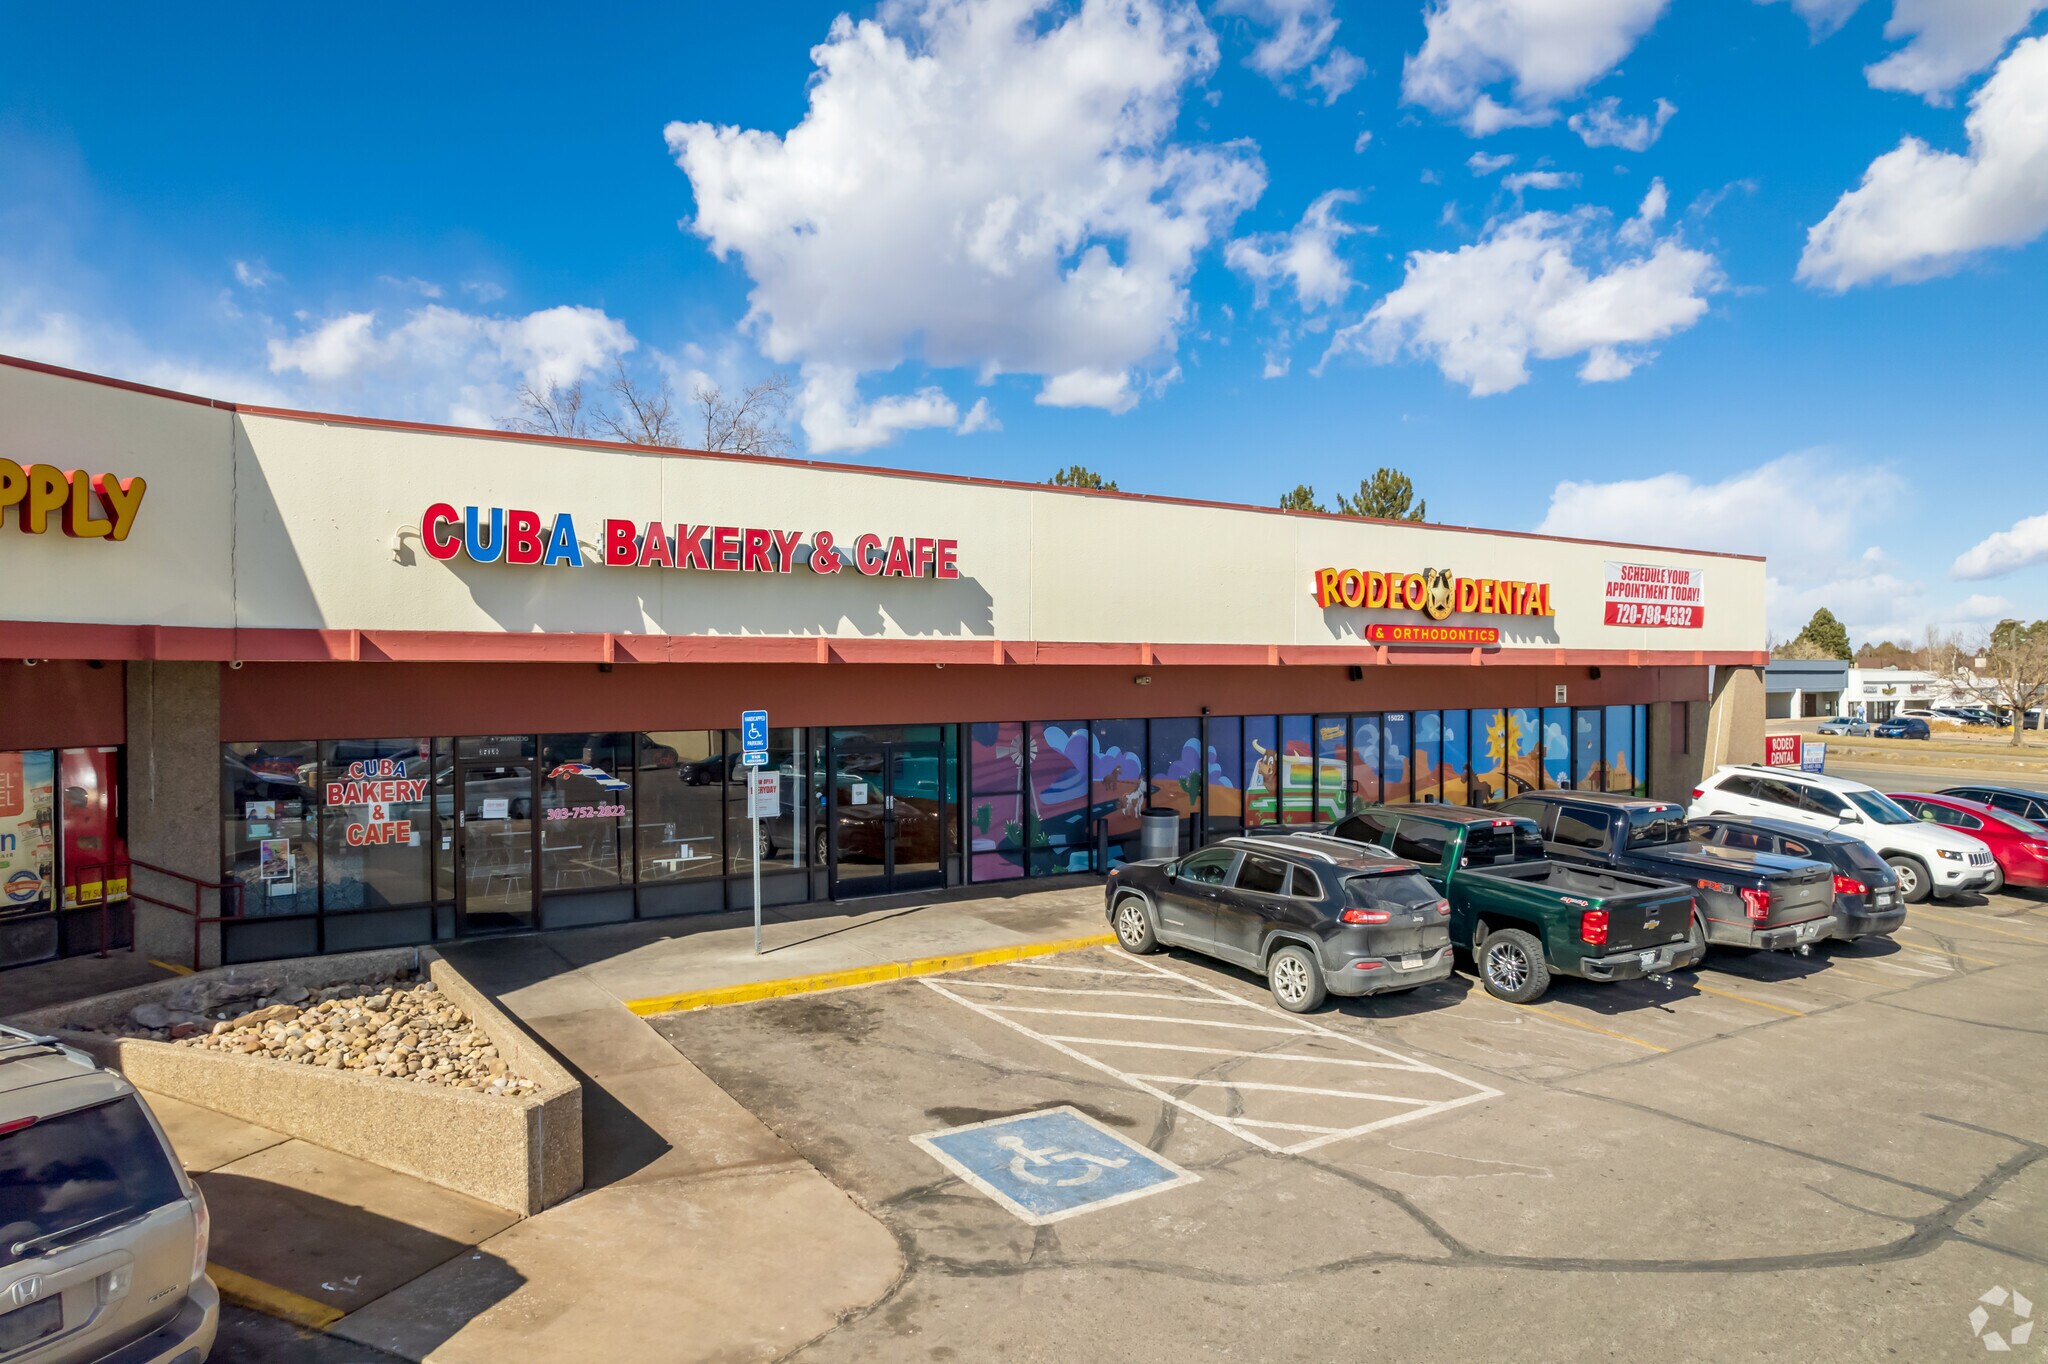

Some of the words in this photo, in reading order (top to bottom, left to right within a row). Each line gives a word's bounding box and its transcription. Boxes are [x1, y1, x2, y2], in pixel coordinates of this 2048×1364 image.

[421, 503, 584, 567] CUBA
[604, 518, 803, 573] BAKERY
[809, 530, 842, 575] &
[854, 533, 959, 579] CAFE
[1621, 565, 1666, 583] SCHEDULE
[1668, 569, 1690, 585] YOUR
[1315, 567, 1427, 611] RODEO
[1456, 577, 1556, 616] DENTAL
[1606, 581, 1669, 600] APPOINTMENT
[1671, 585, 1700, 602] TODAY!
[1616, 603, 1692, 626] 720-798-4332
[1376, 627, 1385, 639] &
[1394, 628, 1496, 641] ORTHODONTICS
[1772, 737, 1795, 751] RODEO
[1771, 751, 1795, 764] DENTAL
[349, 759, 407, 779] CUBA
[327, 779, 428, 806] BAKERY
[372, 804, 385, 820] &
[547, 805, 626, 820] 303-752-2822
[346, 820, 411, 846] CAFE
